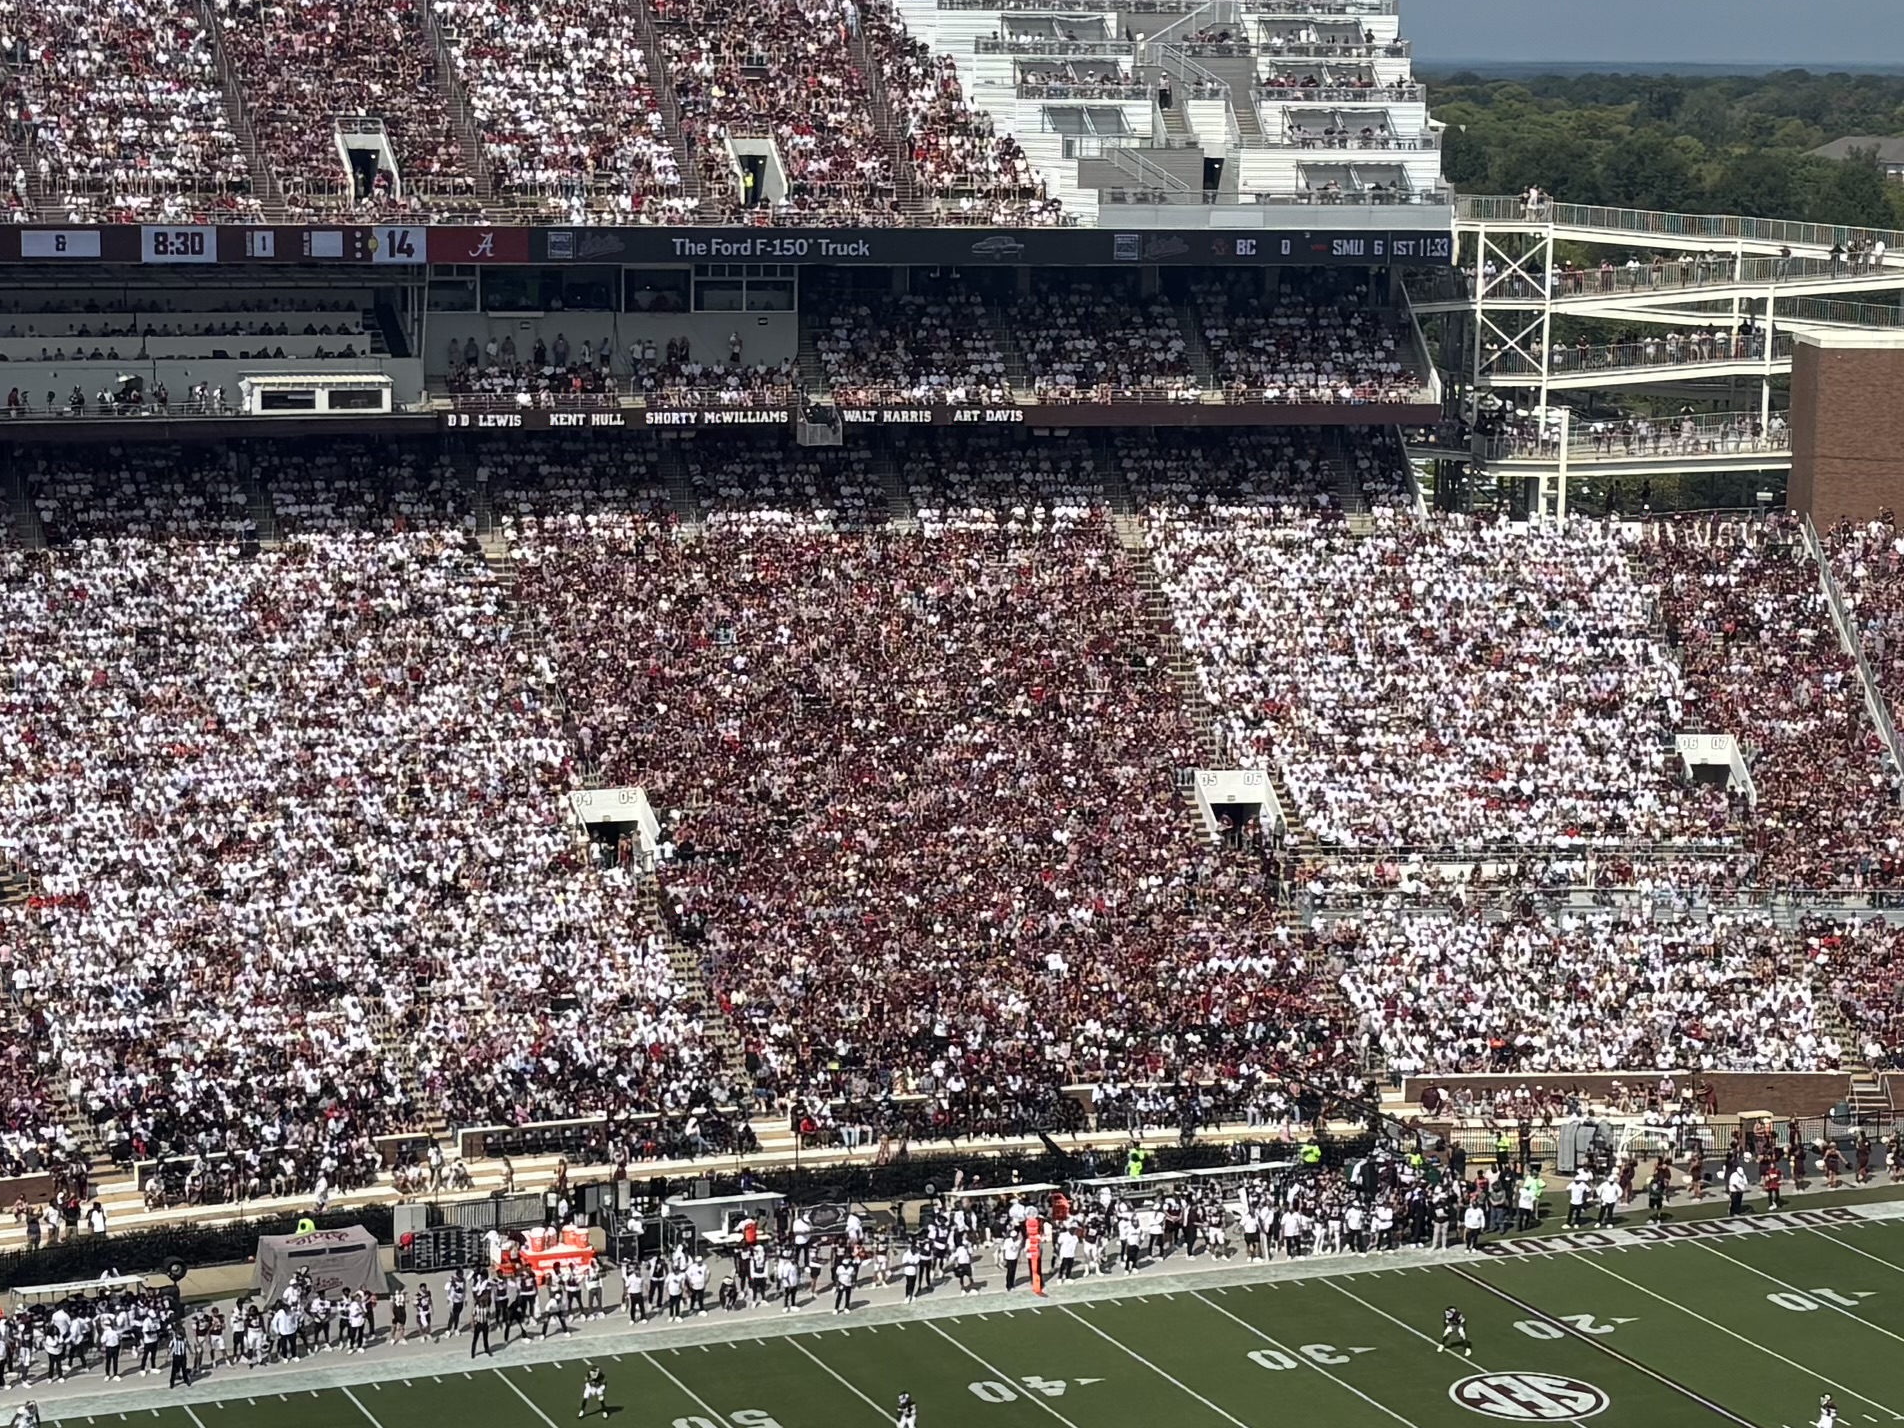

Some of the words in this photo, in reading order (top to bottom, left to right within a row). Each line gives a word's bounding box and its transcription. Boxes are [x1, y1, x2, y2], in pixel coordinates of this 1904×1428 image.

[55, 234, 66, 252] &
[154, 231, 204, 256] 8:30
[386, 231, 415, 259] 14
[468, 232, 495, 259] A
[672, 238, 709, 257] The
[711, 238, 753, 256] Ford
[817, 238, 870, 257] Truck
[1235, 239, 1257, 256] BC
[1332, 239, 1365, 256] SMU
[1373, 239, 1383, 256] 6
[1393, 240, 1416, 256] 1ST
[447, 414, 457, 427] D
[461, 414, 470, 427] D
[478, 414, 522, 427] LEWIS
[549, 413, 586, 426] KENT
[591, 413, 625, 426] HULL
[645, 411, 697, 425] SHORTY
[704, 411, 789, 424] McWILLIAMS
[842, 410, 878, 422] WALT
[883, 410, 932, 423] HARRIS
[953, 410, 981, 422] ART
[985, 409, 1024, 422] DAVIS
[618, 790, 638, 805] 05
[1480, 1230, 1614, 1257] CLUB
[1767, 1288, 1859, 1311] 10
[1513, 1313, 1616, 1340] 20
[1245, 1341, 1352, 1371] 30
[967, 1374, 1070, 1403] 40
[1463, 1374, 1597, 1419] SEC
